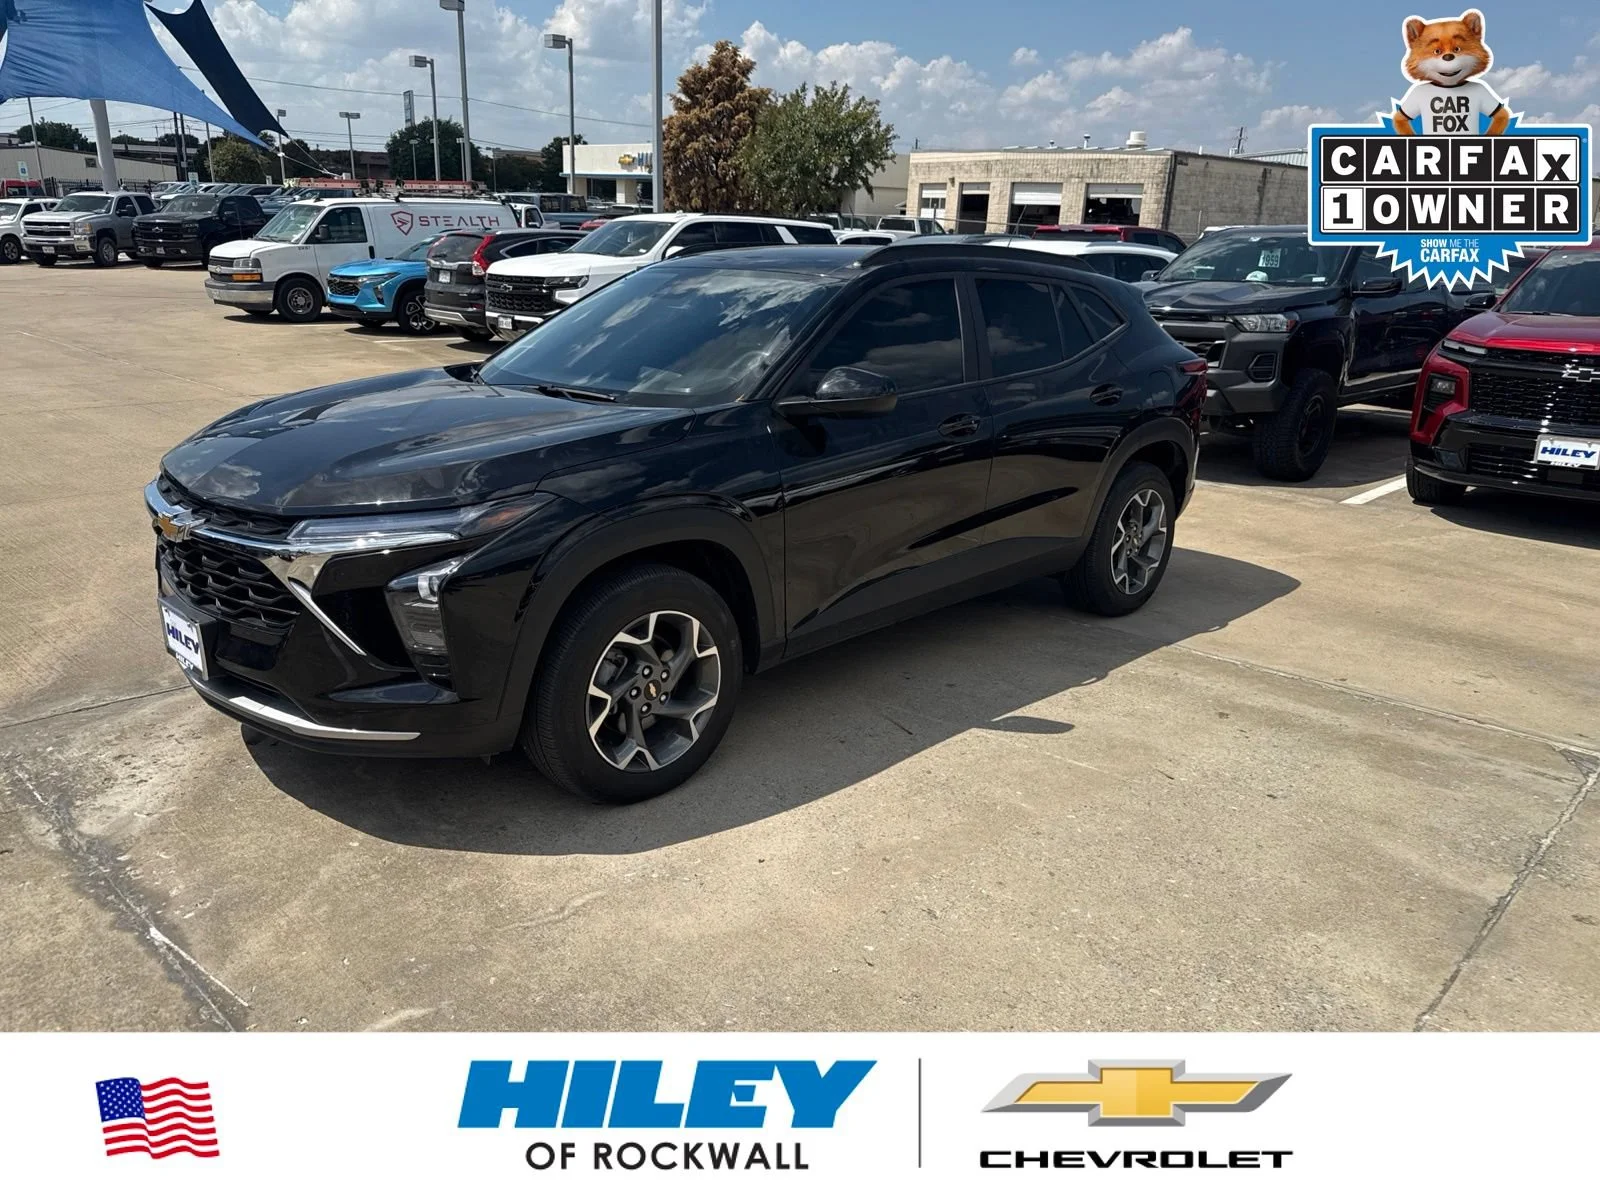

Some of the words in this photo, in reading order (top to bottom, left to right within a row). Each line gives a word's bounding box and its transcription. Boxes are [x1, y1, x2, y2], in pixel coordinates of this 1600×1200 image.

[418, 215, 500, 227] STEALTH
[1540, 446, 1597, 459] HILEY
[166, 622, 200, 655] HILEY
